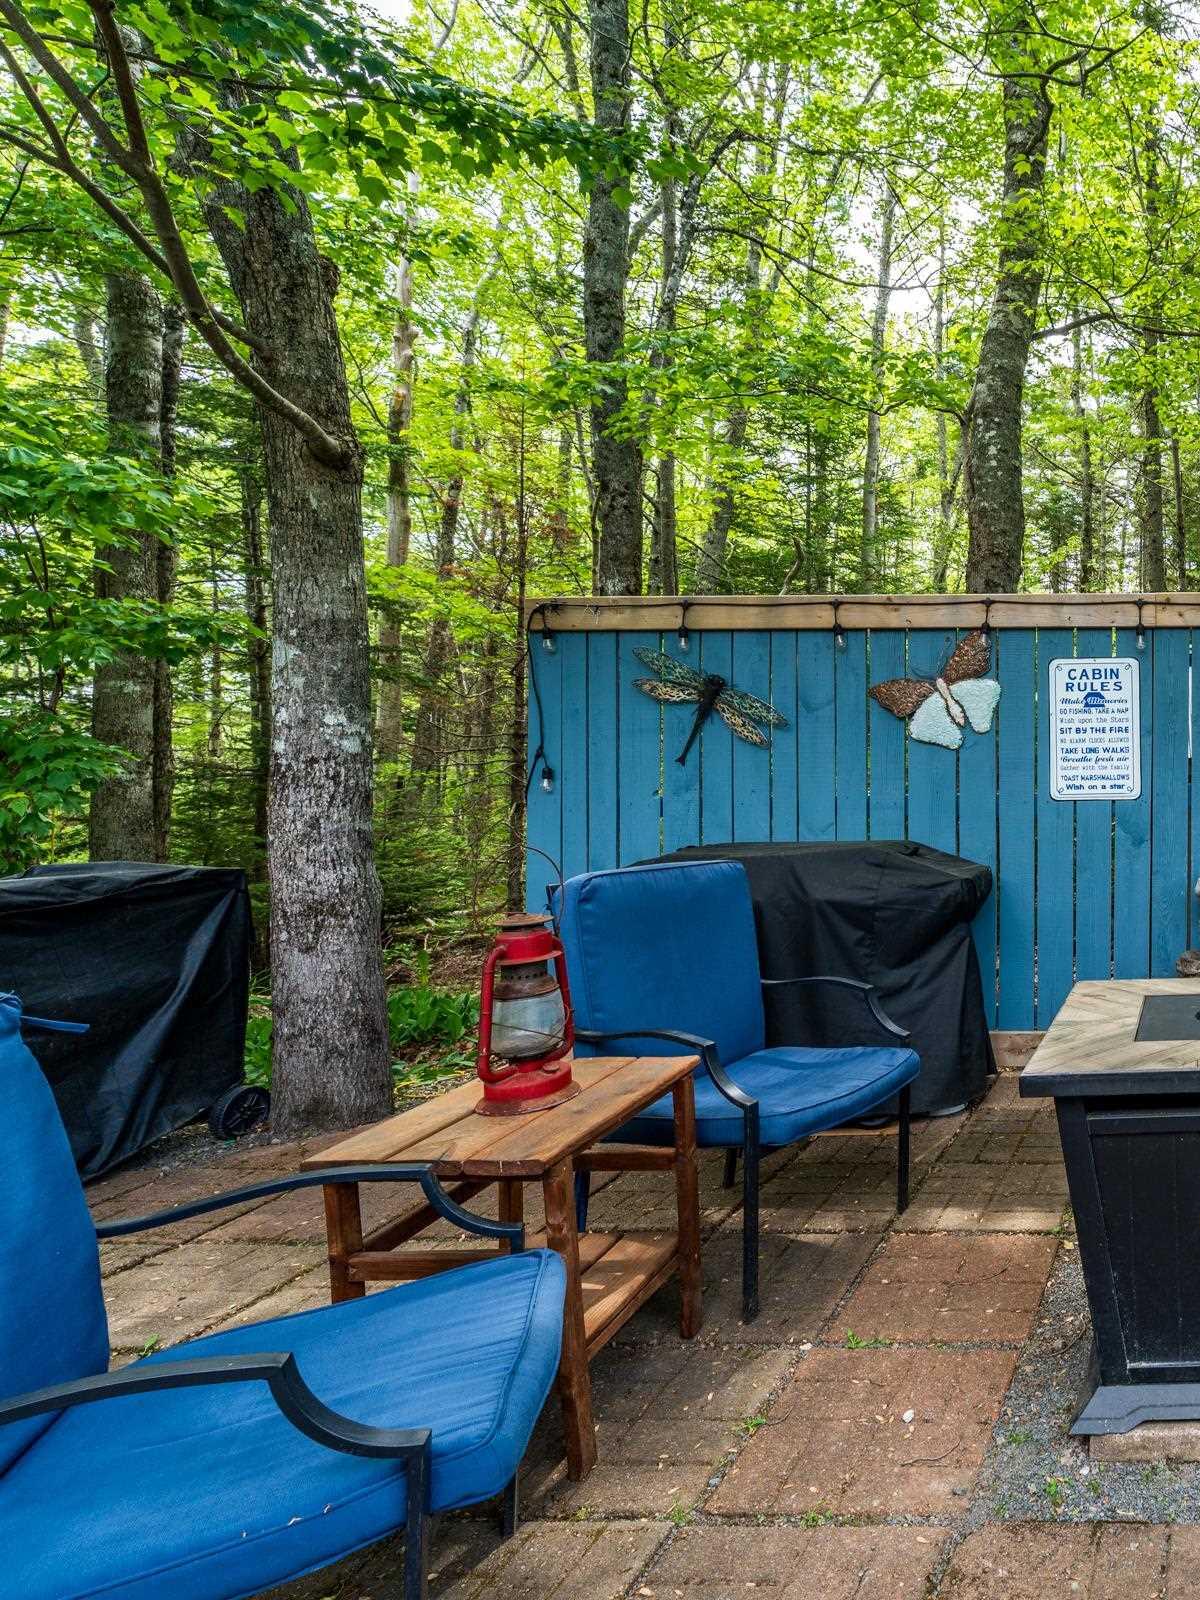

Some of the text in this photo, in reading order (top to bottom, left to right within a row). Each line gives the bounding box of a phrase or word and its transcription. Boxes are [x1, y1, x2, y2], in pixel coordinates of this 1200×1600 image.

[1068, 668, 1119, 680] CABIN
[1065, 681, 1123, 691] RULES
[1109, 726, 1129, 734] FIRE
[1095, 755, 1114, 764] fresh
